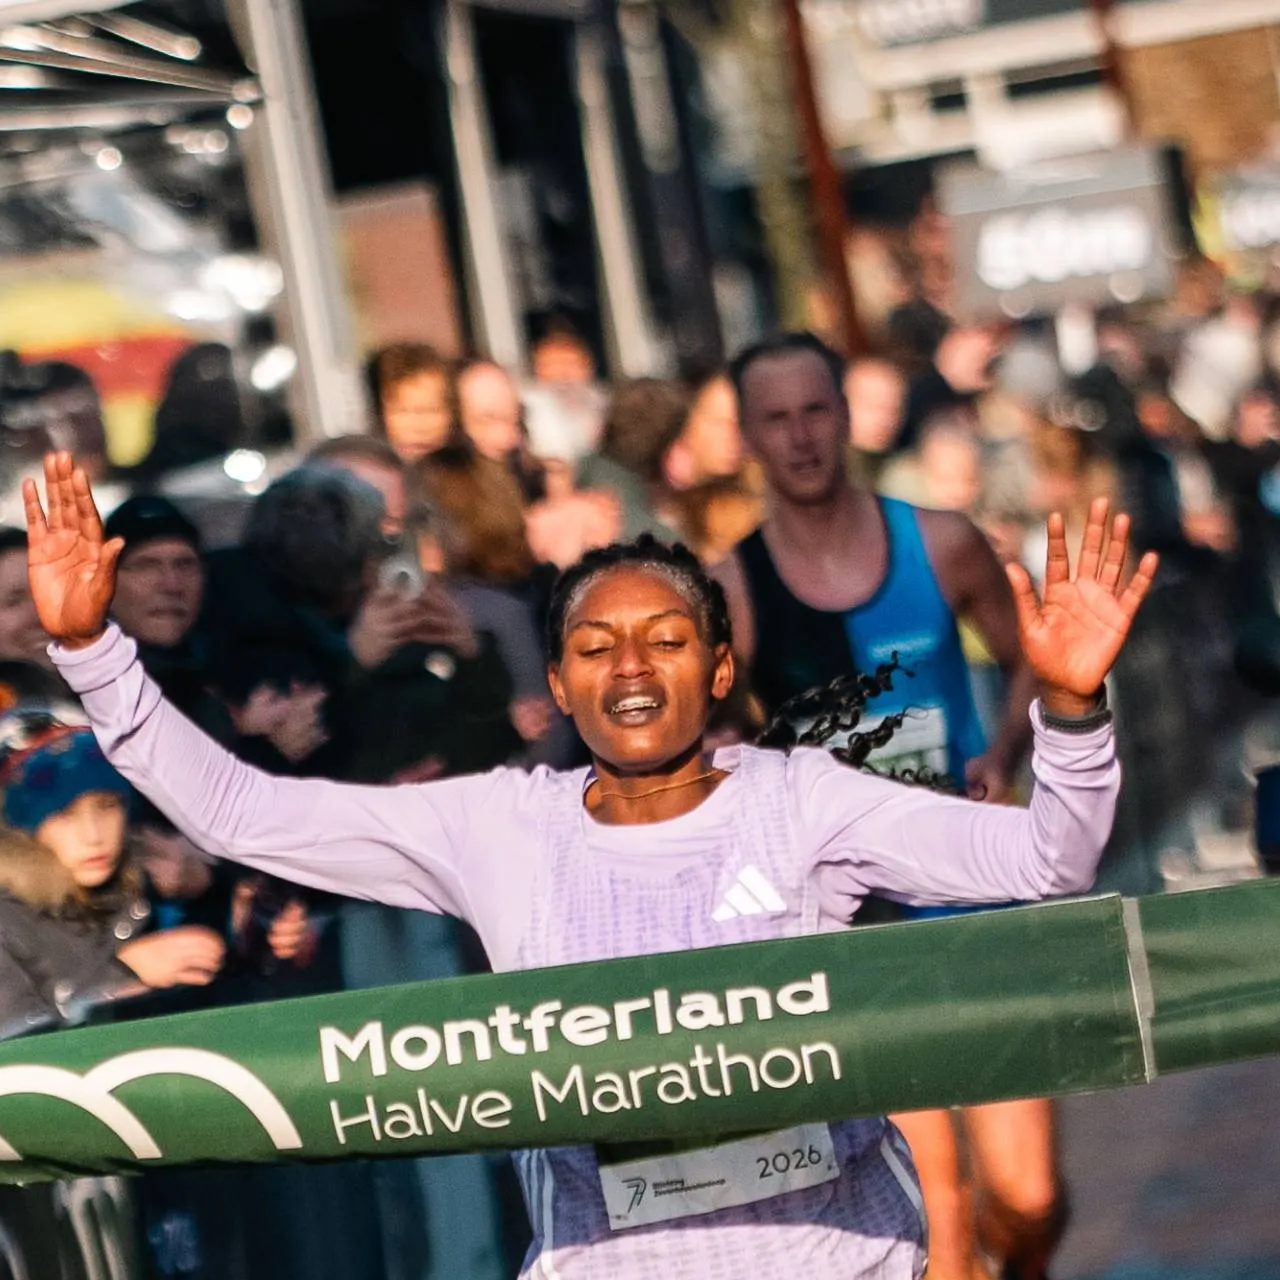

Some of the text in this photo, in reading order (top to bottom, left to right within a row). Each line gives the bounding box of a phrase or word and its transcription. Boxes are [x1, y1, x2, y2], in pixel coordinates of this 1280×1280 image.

[320, 972, 831, 1084] Montferland
[329, 1041, 842, 1146] Halve Marathon
[756, 1145, 822, 1179] 2026
